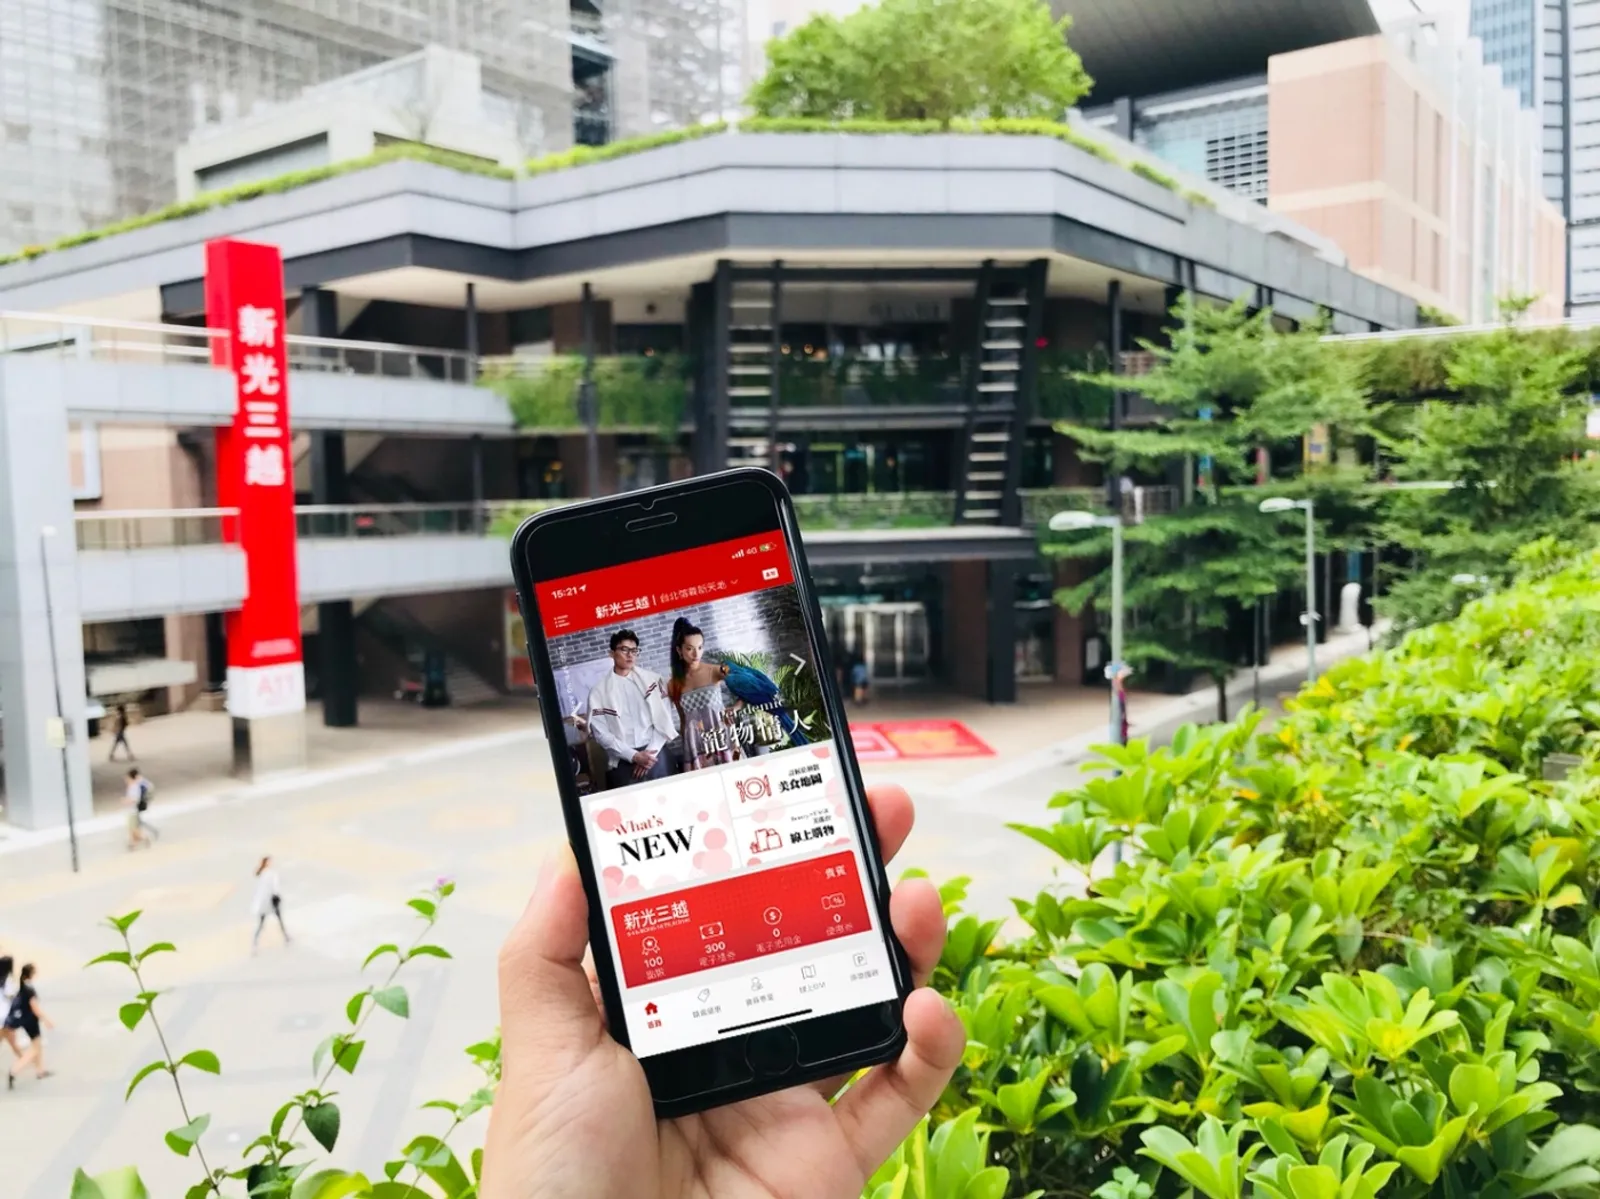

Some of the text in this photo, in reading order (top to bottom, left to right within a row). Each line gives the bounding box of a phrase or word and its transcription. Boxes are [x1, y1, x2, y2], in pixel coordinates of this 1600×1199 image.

[238, 306, 286, 486] 新光三越
[551, 586, 578, 599] 15:21
[595, 596, 651, 619] 新光三越
[778, 773, 823, 793] 美食地圖
[615, 814, 664, 836] What's
[789, 824, 835, 845] 線上購物
[618, 826, 695, 866] NEW
[624, 900, 690, 930] 新光三越
[704, 941, 726, 955] 300
[643, 956, 664, 969] 100
